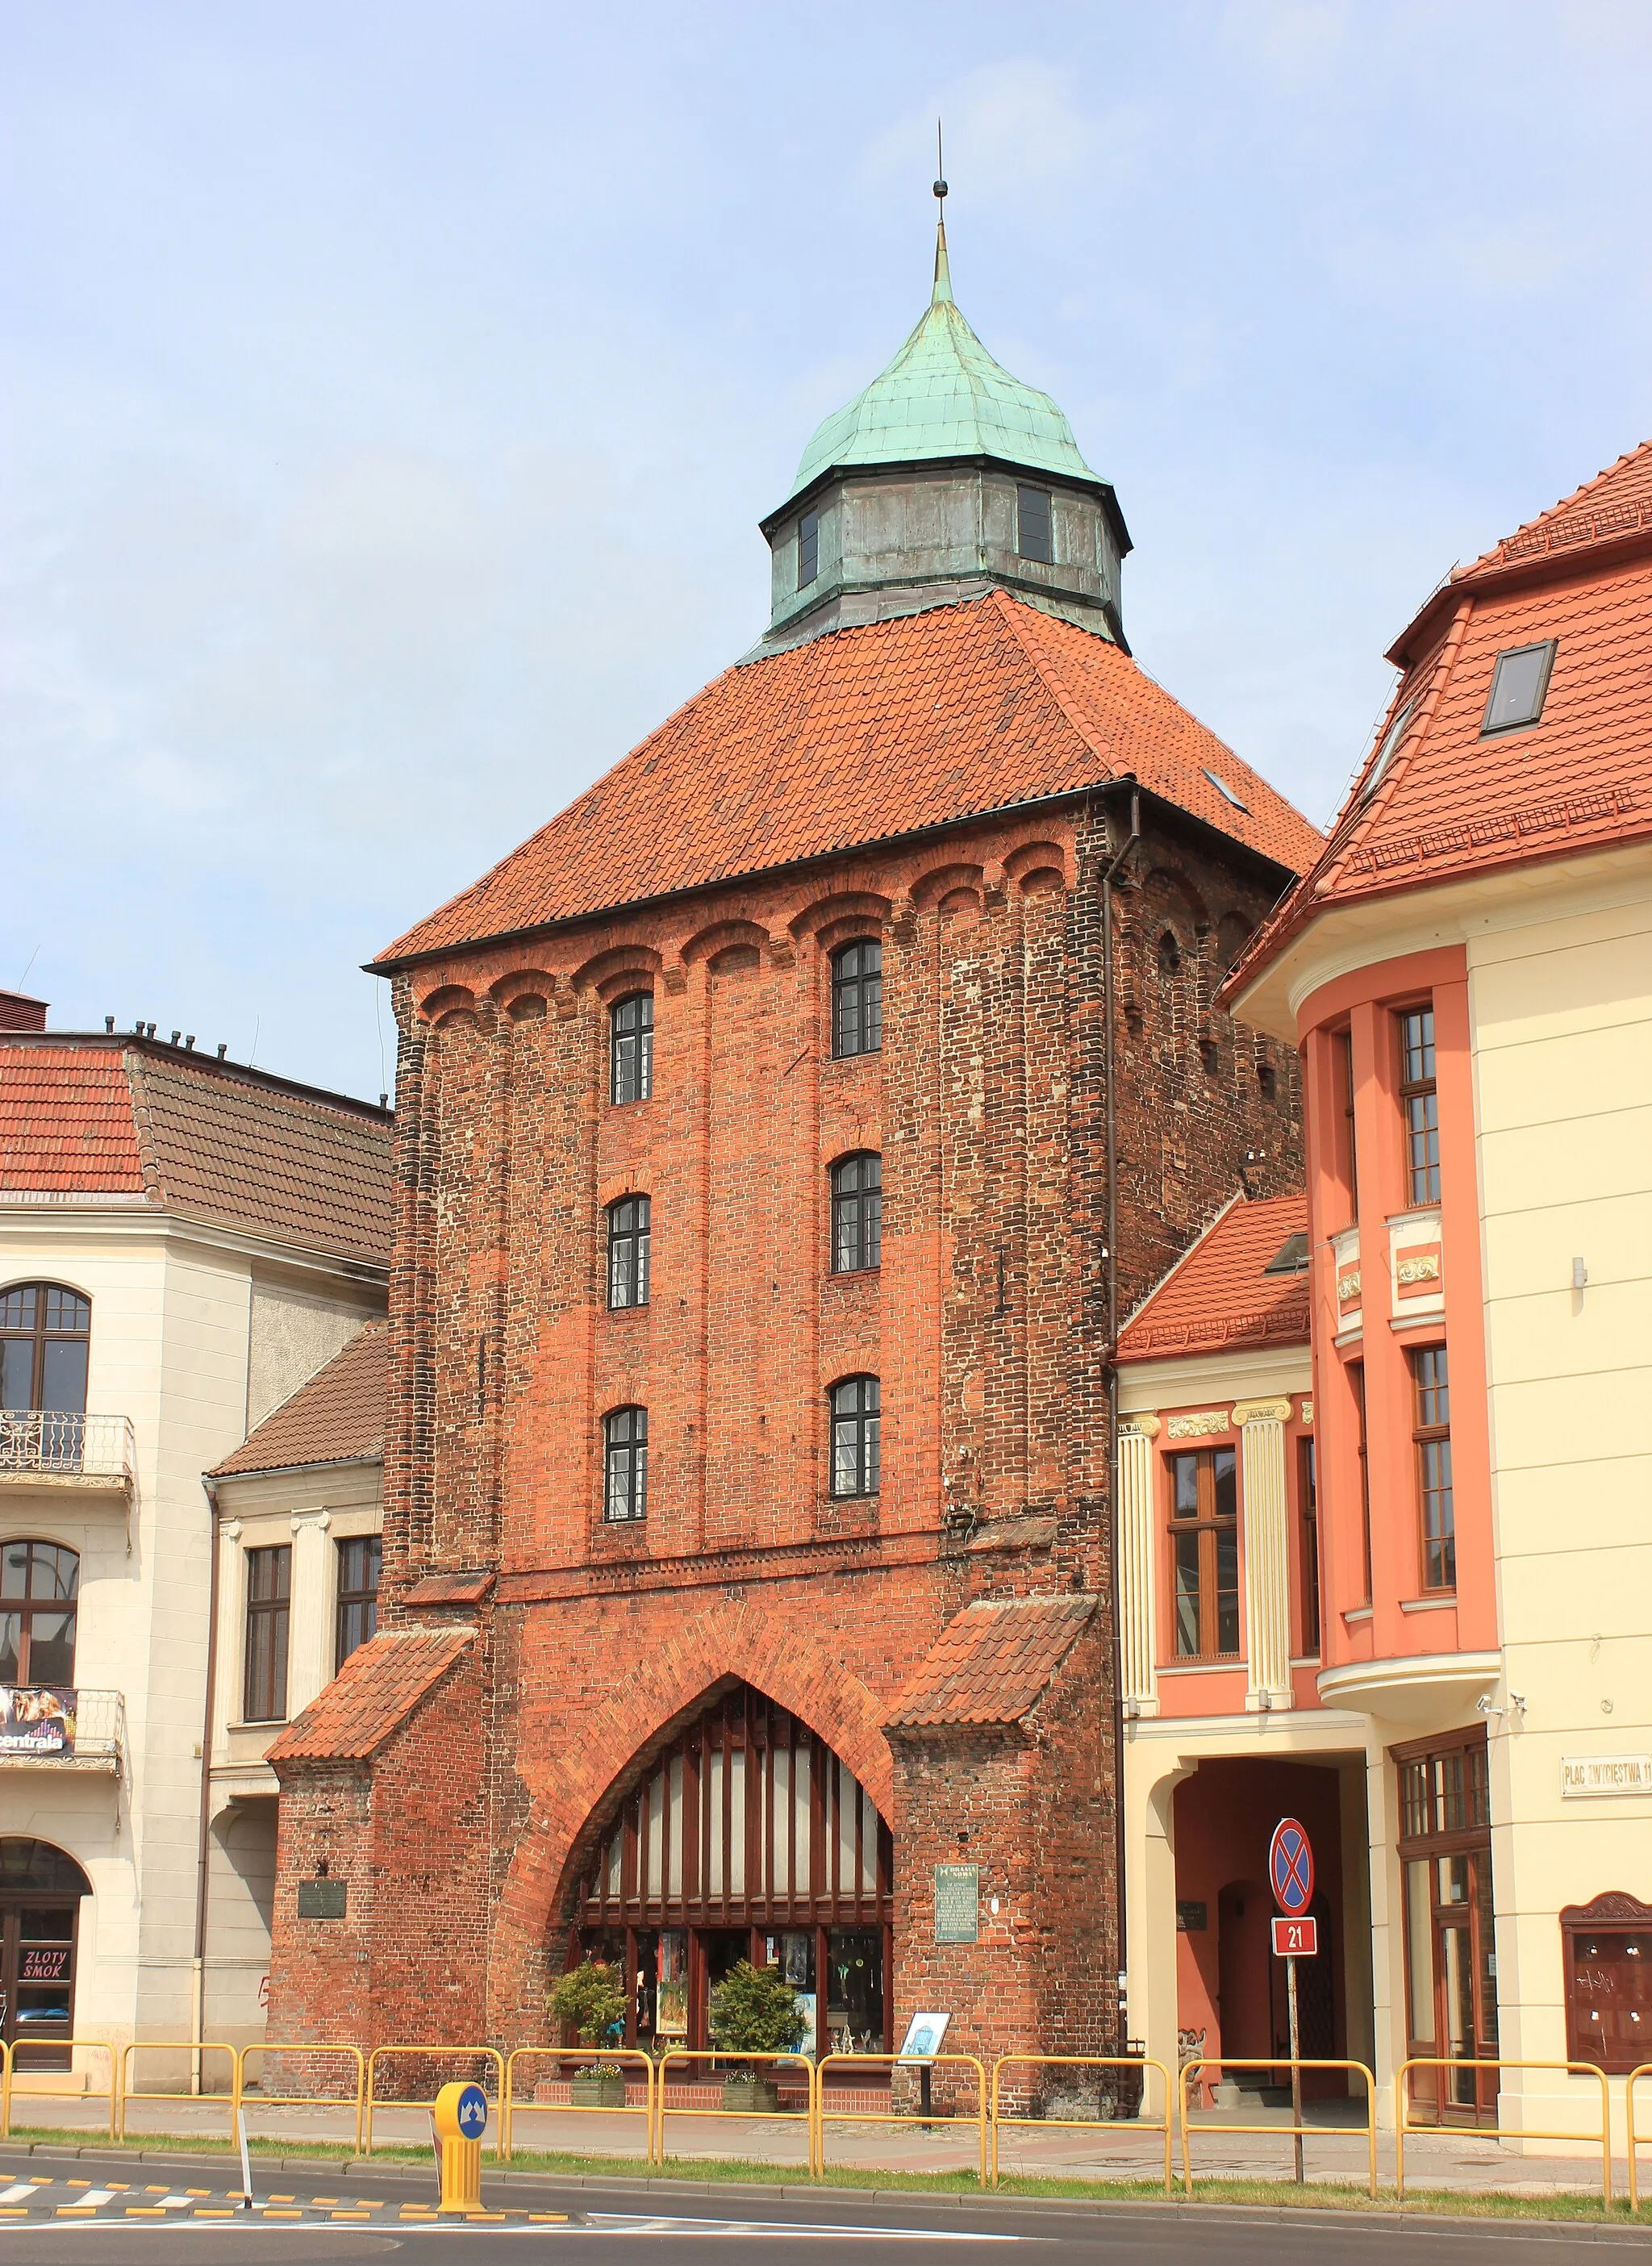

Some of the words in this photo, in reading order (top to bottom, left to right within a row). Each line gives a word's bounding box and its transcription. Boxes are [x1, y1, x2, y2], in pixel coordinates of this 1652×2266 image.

[1565, 1764, 1585, 1785] PLAC
[1588, 1762, 1642, 1786] ZWYCIĘSTWA
[1287, 1926, 1303, 1948] 21
[25, 1951, 68, 1965] ZLOTY
[23, 1965, 63, 1978] SMOK
